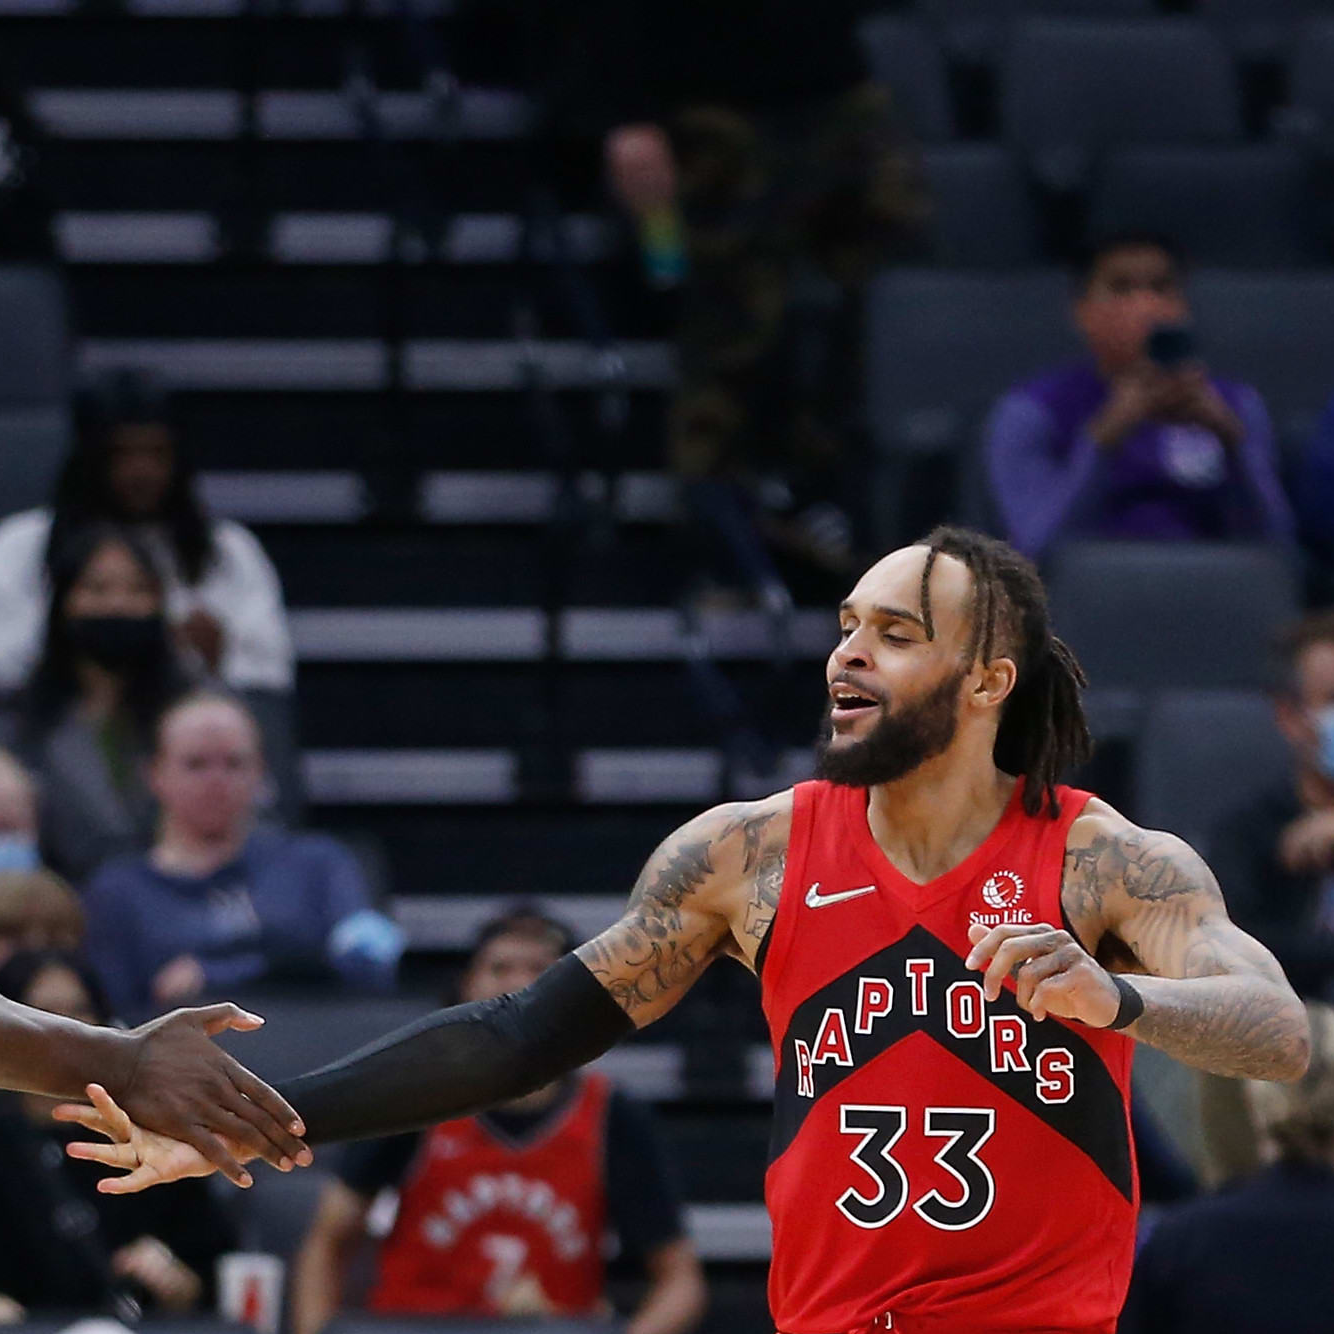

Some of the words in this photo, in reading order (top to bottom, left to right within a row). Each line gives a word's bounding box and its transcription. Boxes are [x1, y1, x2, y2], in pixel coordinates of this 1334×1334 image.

[969, 911, 1000, 925] Sun
[1003, 908, 1033, 923] Life
[794, 958, 1074, 1104] RAPTORS
[835, 1104, 995, 1231] 33
